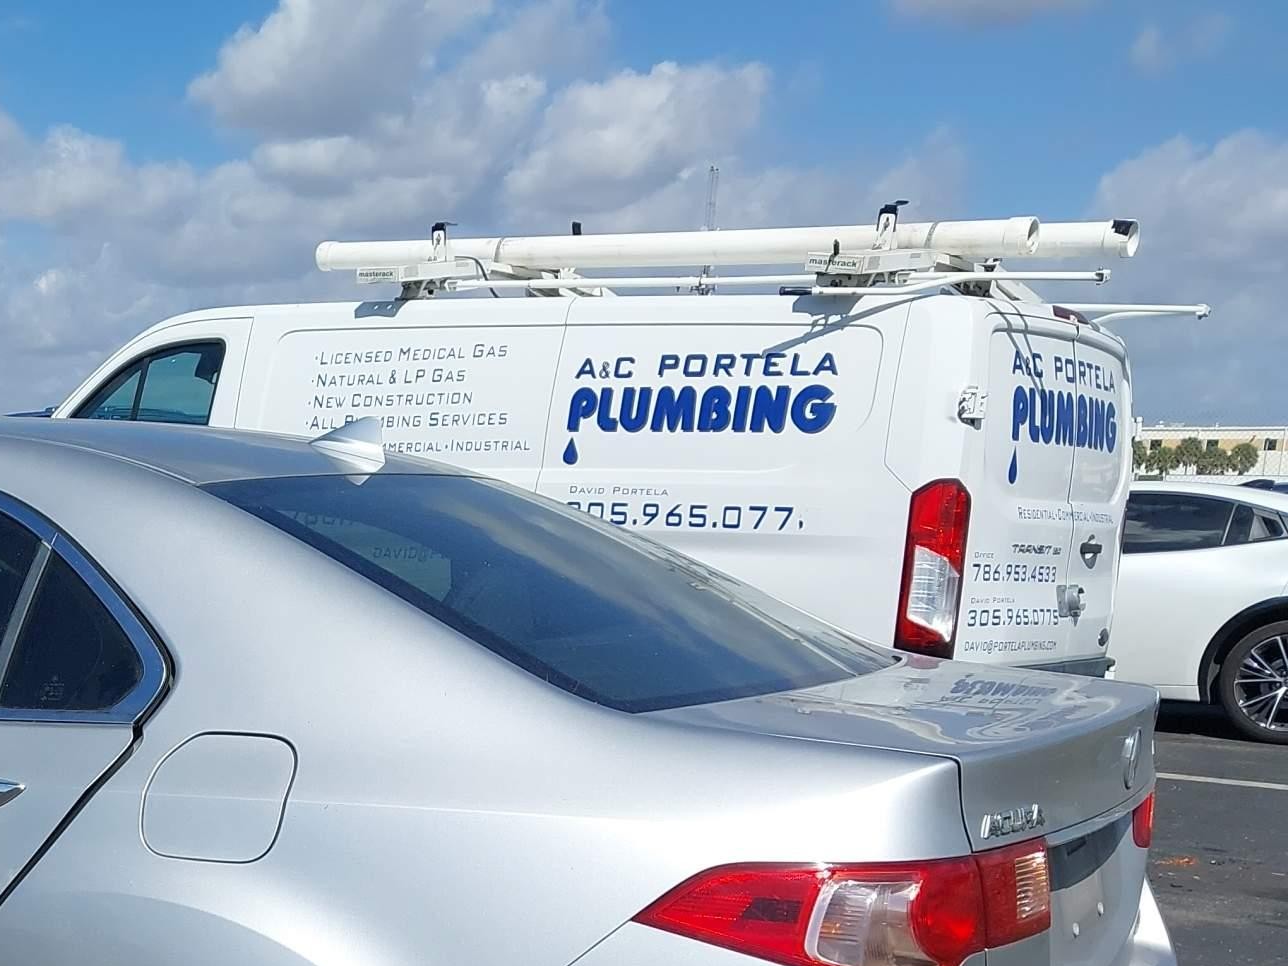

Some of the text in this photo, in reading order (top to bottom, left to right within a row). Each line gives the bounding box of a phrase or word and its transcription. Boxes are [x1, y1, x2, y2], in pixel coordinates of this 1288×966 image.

[319, 343, 508, 366] LICENSED MEDICAL GAS
[575, 352, 839, 379] A&C PORTELA
[1012, 349, 1116, 393] A&C PORTELA
[316, 368, 467, 388] NATURAL & LP GAS
[313, 391, 473, 409] NEW CONSTRUCTION
[566, 383, 838, 435] PLUMBING
[309, 415, 337, 430] ALL
[428, 411, 508, 427] SERVICES
[1011, 385, 1117, 454] PLUMBING
[569, 485, 669, 496] DAVID PORTELA
[972, 563, 1057, 583] 786.953.4533
[967, 608, 1059, 627] 305.965.0775
